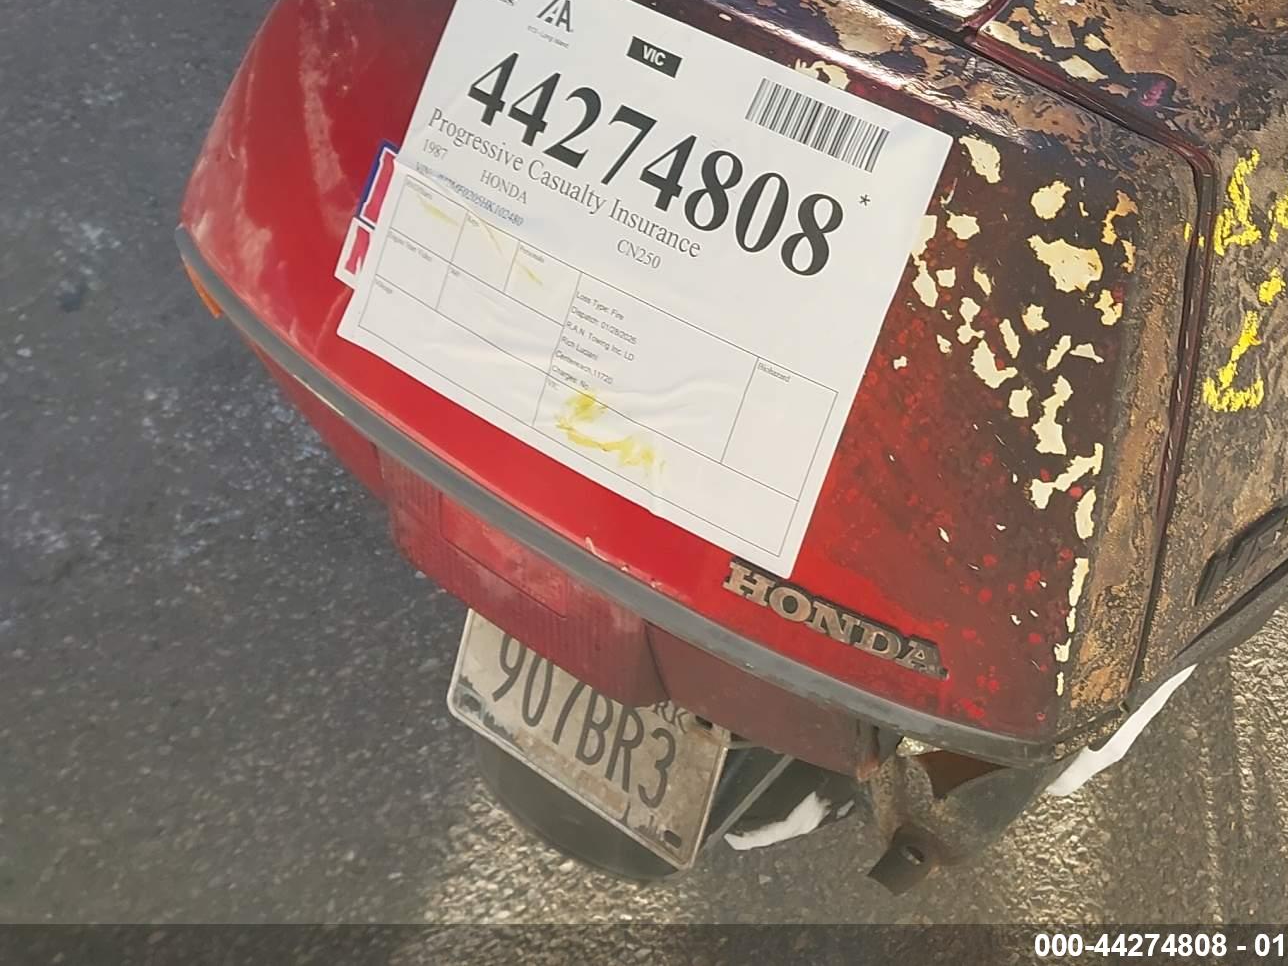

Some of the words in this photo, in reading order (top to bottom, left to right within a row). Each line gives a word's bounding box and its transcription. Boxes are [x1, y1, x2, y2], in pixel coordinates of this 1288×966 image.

[642, 44, 667, 67] VIC
[422, 138, 448, 160] 1987
[480, 170, 528, 205] HONDA
[617, 238, 661, 269] CN250
[428, 107, 524, 172] Progressive
[528, 159, 606, 215] Casualty
[608, 198, 701, 257] Insurance
[467, 52, 844, 276] 44274808
[576, 291, 591, 304] Loss
[611, 309, 625, 320] Fire
[589, 333, 610, 351] Towing
[723, 561, 949, 680] HONDA
[491, 634, 677, 809] 907BR3
